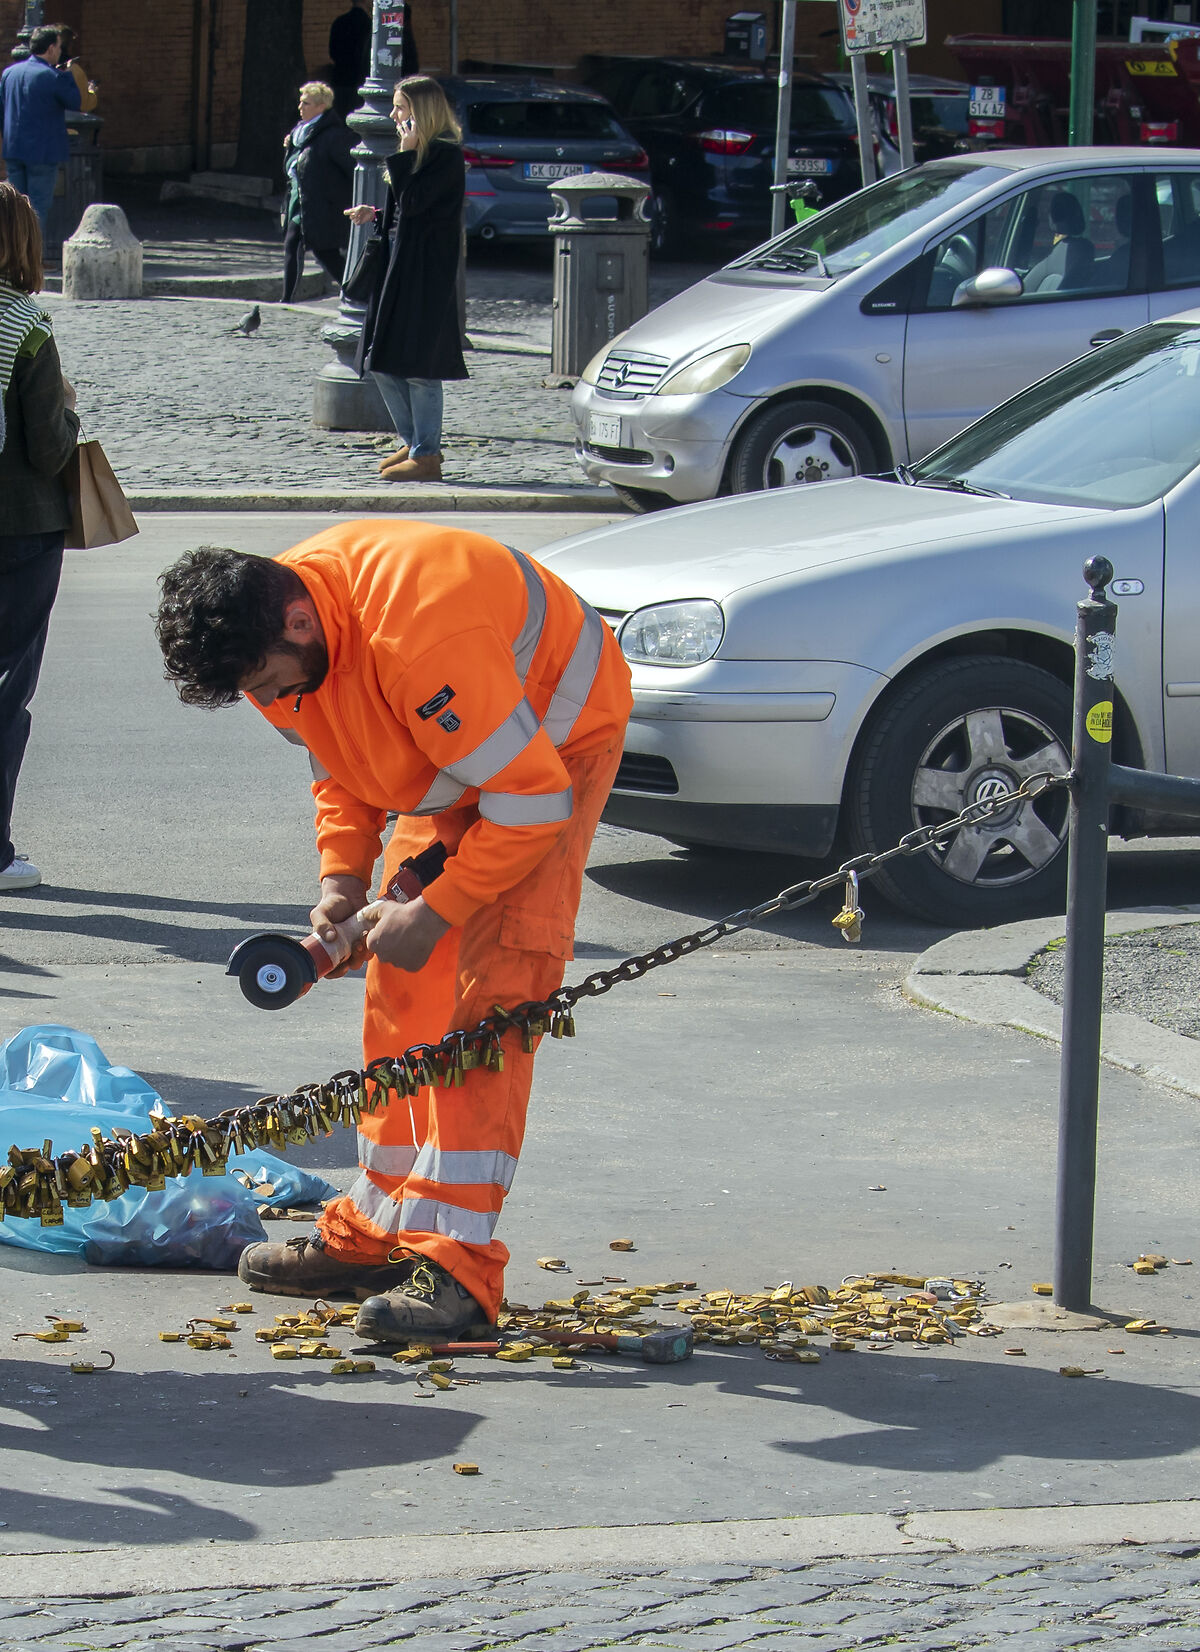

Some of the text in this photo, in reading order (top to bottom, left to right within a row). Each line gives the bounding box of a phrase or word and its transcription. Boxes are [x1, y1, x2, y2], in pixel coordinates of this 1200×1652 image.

[981, 88, 993, 100] ZB
[971, 102, 1004, 115] 514 AZ
